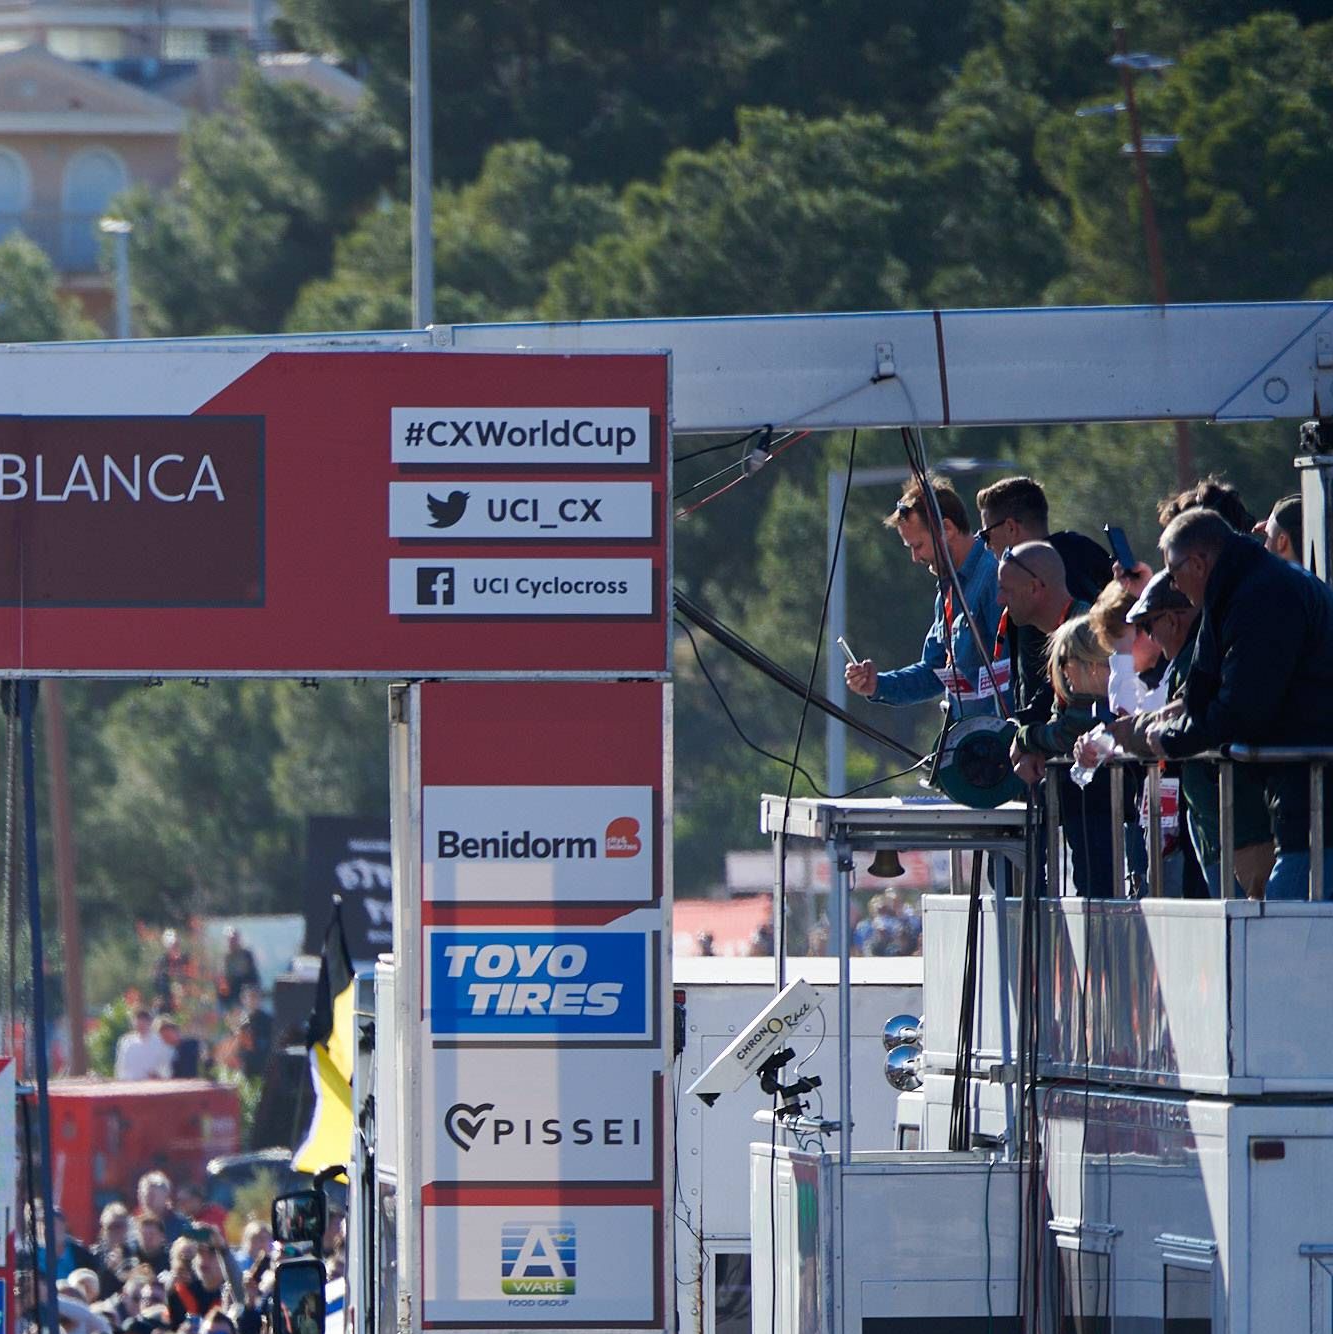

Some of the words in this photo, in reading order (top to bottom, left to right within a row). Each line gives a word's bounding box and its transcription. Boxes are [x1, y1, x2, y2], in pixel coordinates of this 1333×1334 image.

[405, 419, 637, 455] #CXWorldCup
[487, 498, 603, 529] UCI_CX
[473, 577, 509, 595] UCI
[515, 576, 628, 599] Cyclocross
[437, 830, 597, 859] Benidorm
[444, 943, 588, 979] TOYO
[468, 982, 624, 1016] TIRES
[493, 1119, 640, 1145] PISSEI
[512, 1281, 566, 1293] WARE
[537, 1299, 570, 1307] GROUP
